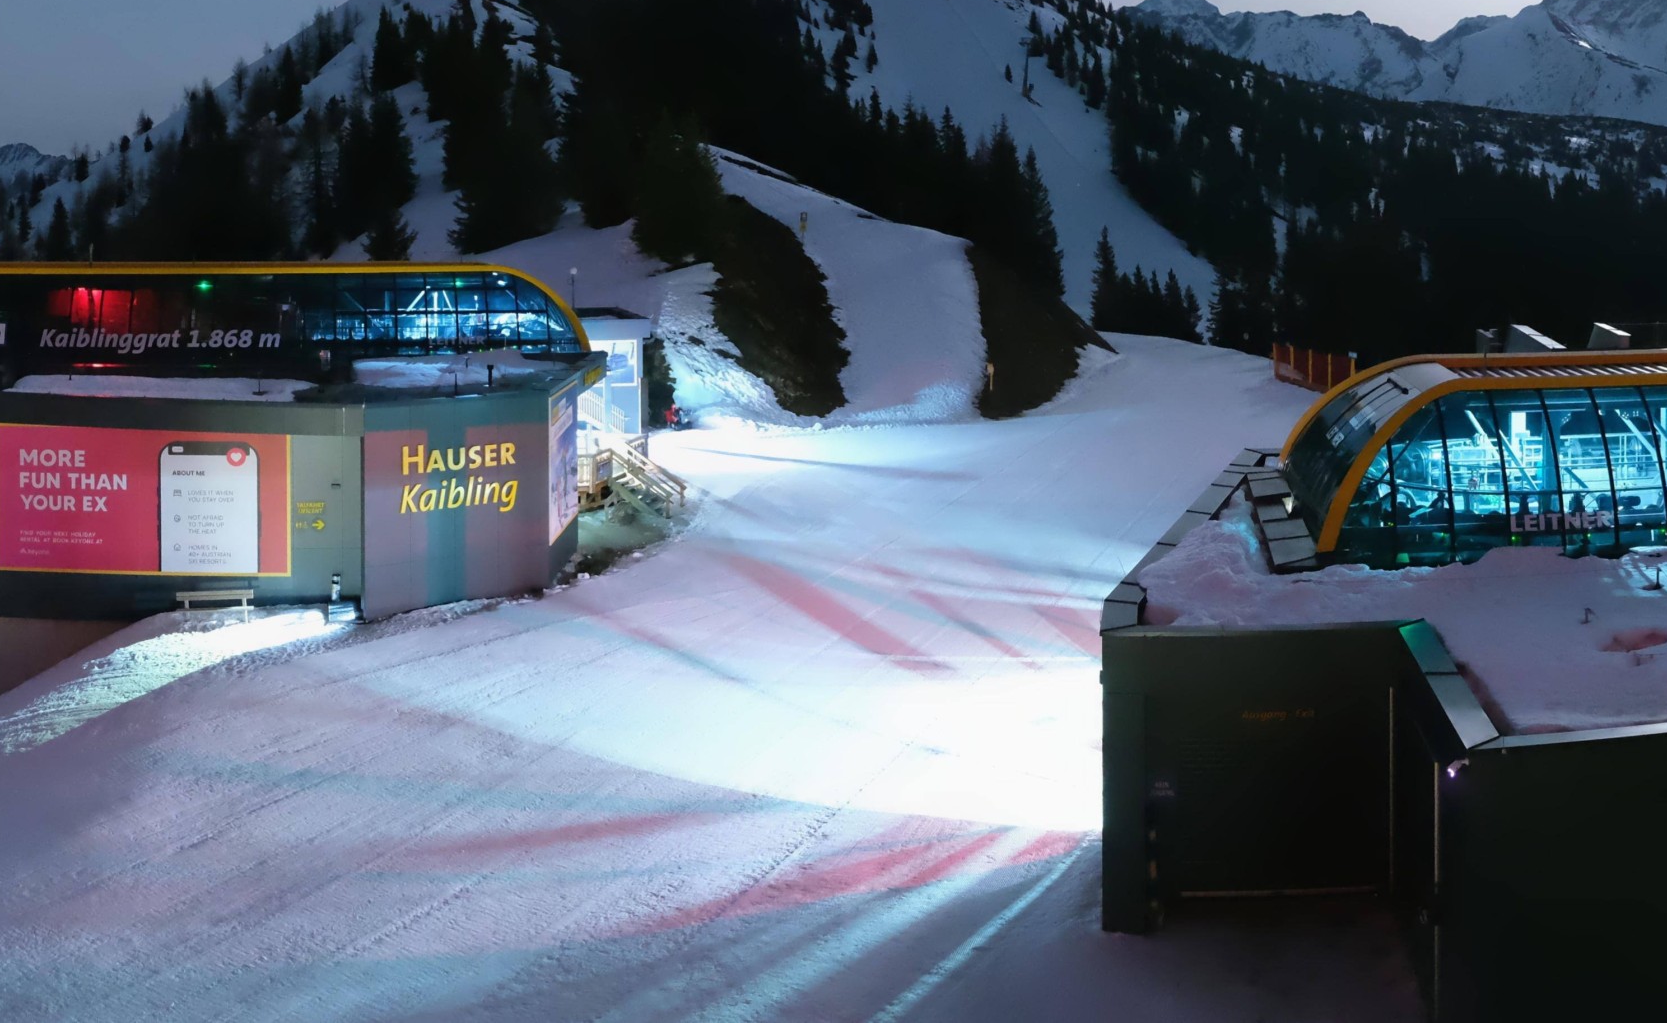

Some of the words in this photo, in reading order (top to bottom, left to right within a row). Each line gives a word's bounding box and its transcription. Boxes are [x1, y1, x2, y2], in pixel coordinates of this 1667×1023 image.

[39, 328, 181, 354] Kaiblinggrat
[187, 329, 253, 348] 1.868
[258, 333, 280, 348] m
[19, 449, 86, 467] MORE
[402, 442, 516, 475] HAUSER
[19, 472, 60, 489] FUN
[68, 473, 127, 490] THAN
[20, 494, 76, 511] YOUR
[82, 496, 108, 512] EX
[400, 476, 518, 514] Kaibling
[1510, 510, 1613, 532] LEITNER
